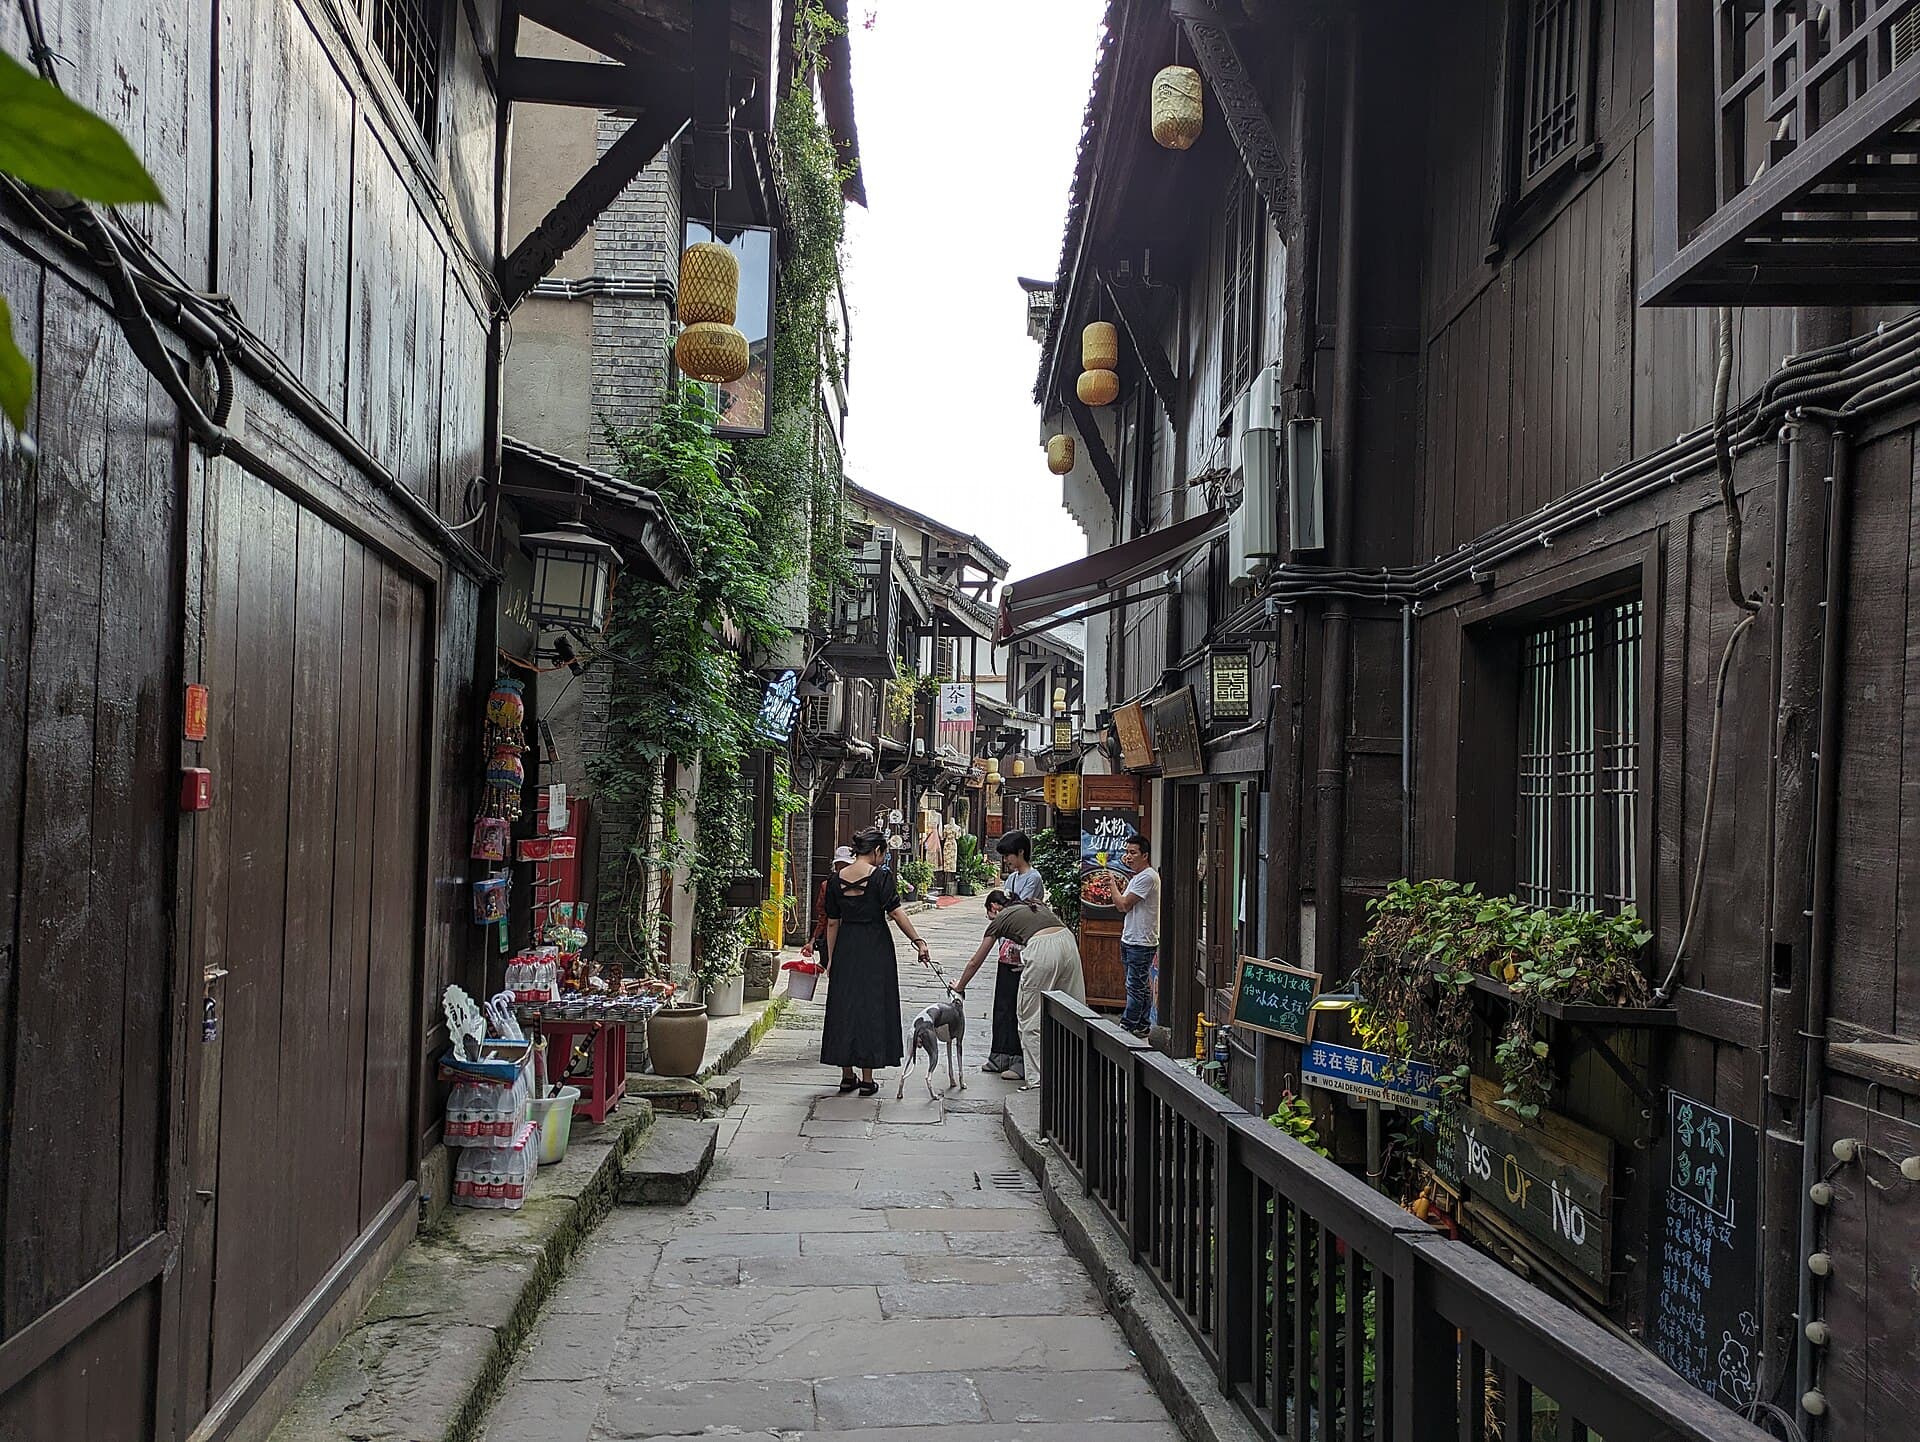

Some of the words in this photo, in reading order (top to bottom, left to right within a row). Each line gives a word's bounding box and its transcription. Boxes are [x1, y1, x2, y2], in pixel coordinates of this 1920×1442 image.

[946, 684, 966, 704] 茶
[1094, 815, 1127, 837] 冰粉
[1244, 964, 1313, 994] 属于我们女孩
[1322, 1078, 1334, 1087] WO
[1334, 1080, 1345, 1090] ZAI
[1345, 1082, 1363, 1094] DENG
[1363, 1086, 1381, 1098] FENG
[1391, 1093, 1410, 1106] DENG
[1410, 1097, 1419, 1107] NI
[1462, 1124, 1491, 1181] Yes
[1503, 1153, 1533, 1209] Or
[1551, 1179, 1586, 1245] No
[1666, 1216, 1712, 1266] 只是我觉得
